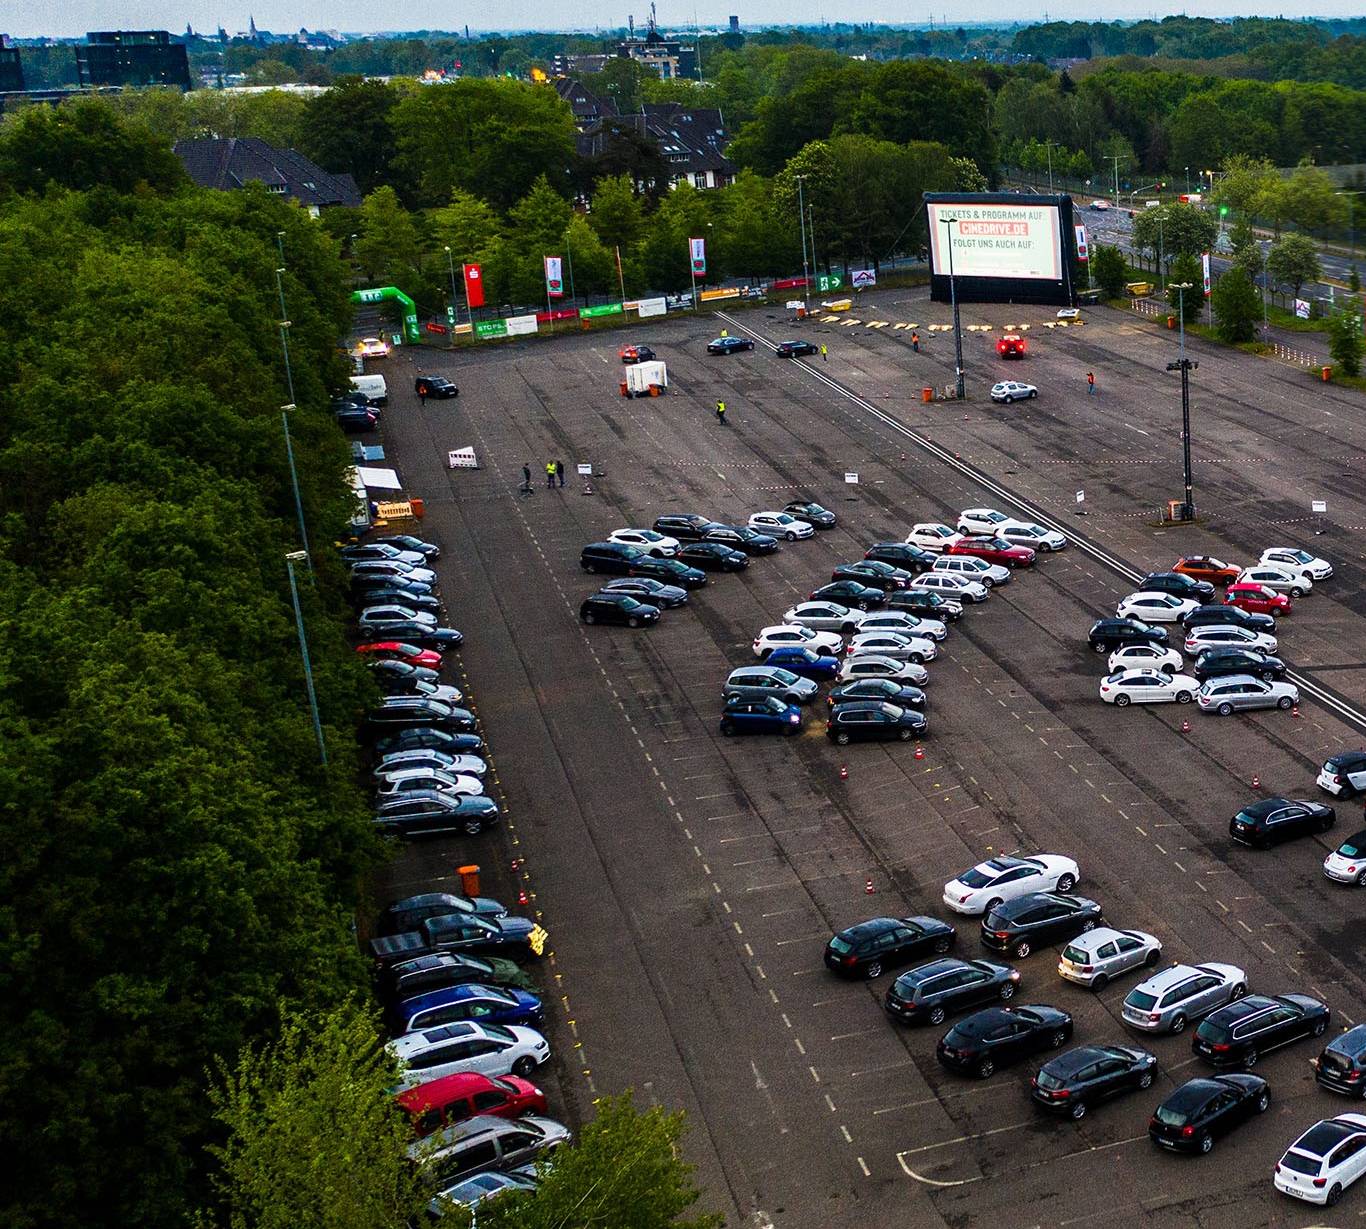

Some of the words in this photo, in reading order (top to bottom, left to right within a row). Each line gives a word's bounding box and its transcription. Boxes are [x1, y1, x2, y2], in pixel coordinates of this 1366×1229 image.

[940, 209, 972, 219] TICKETS
[973, 210, 980, 218] &
[982, 210, 1027, 220] PROGRAMM
[961, 222, 1027, 235] CINEDRIVE.DE
[953, 239, 976, 248] FOLGT
[978, 239, 994, 248] UNS
[995, 240, 1016, 249] AUCH
